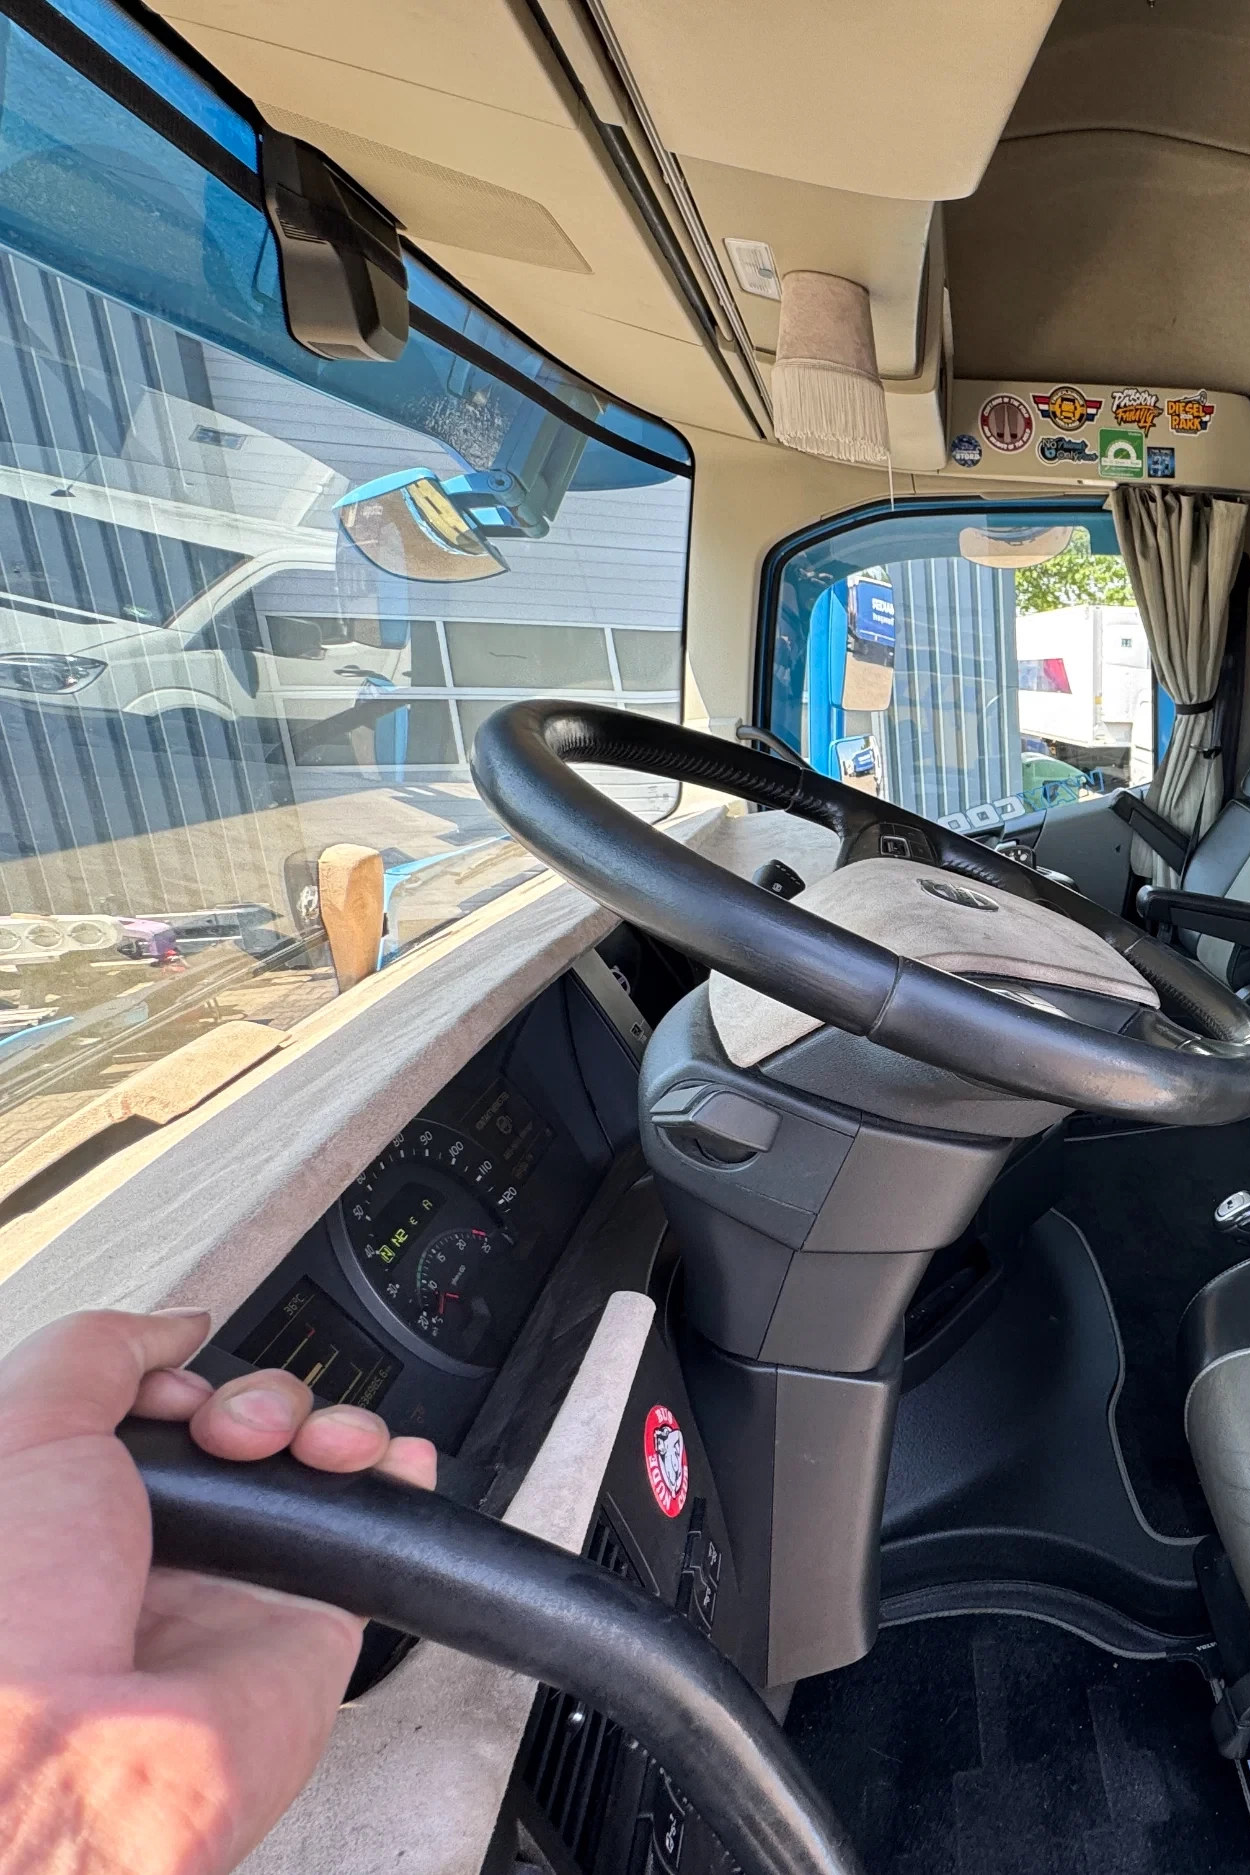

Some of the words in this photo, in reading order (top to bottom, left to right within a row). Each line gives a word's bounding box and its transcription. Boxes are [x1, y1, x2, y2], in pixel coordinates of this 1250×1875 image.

[1168, 401, 1205, 417] DIESEL
[420, 1130, 433, 1146] 90
[448, 1141, 464, 1158] 100
[478, 1160, 493, 1176] 110
[501, 1186, 518, 1203] 120
[352, 1204, 364, 1220] 50
[391, 1228, 409, 1248] N2
[456, 1239, 467, 1251] 20
[364, 1244, 375, 1258] 40
[437, 1251, 446, 1263] 15
[386, 1283, 398, 1299] 30
[427, 1280, 438, 1291] 10
[418, 1315, 429, 1330] 20
[655, 1407, 673, 1425] BUS
[649, 1454, 671, 1511] NUDE
[1195, 1641, 1218, 1652] VOLV
